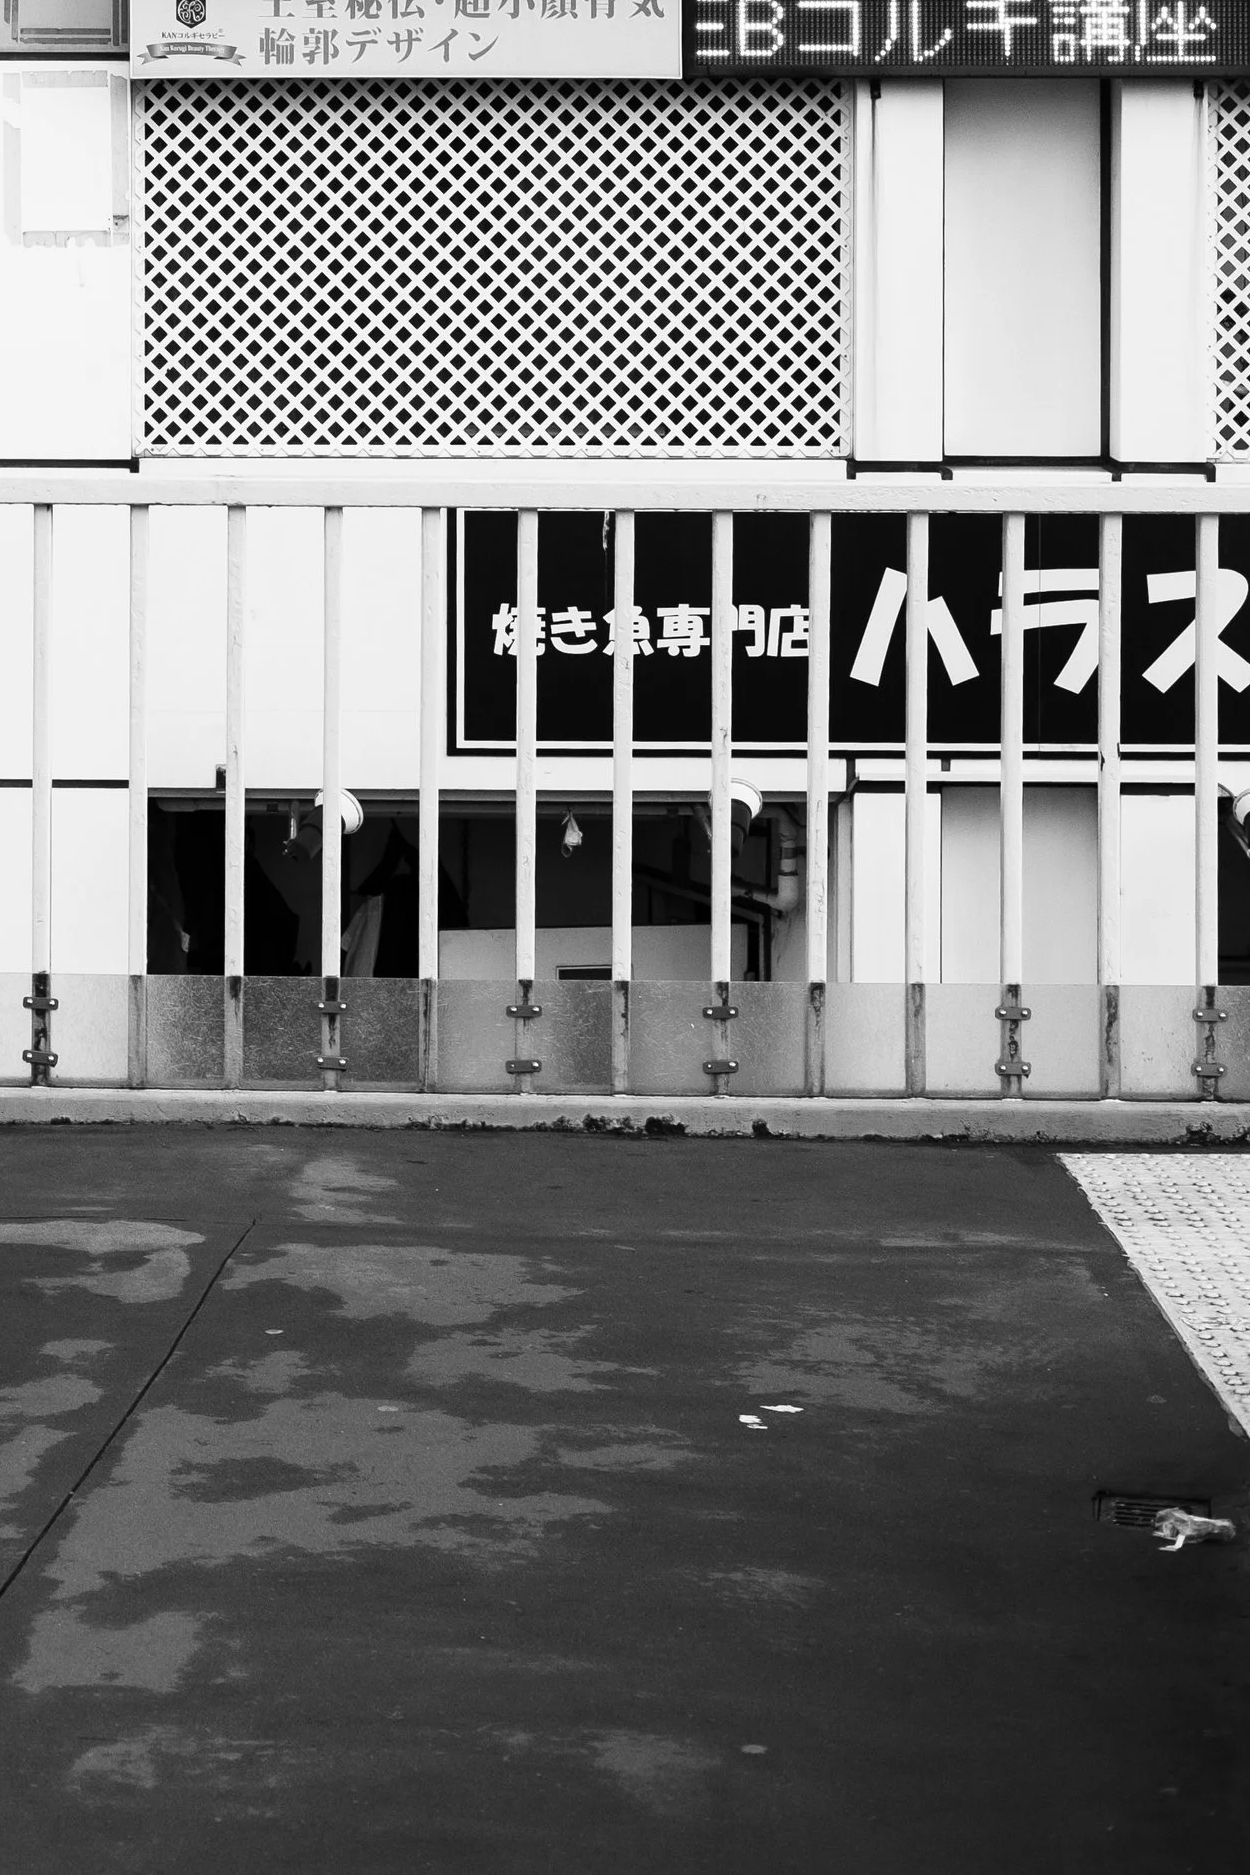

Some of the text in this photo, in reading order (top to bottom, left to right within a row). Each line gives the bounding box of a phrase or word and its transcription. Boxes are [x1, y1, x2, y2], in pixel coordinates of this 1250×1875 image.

[258, 26, 500, 66] 輪郭デザイン
